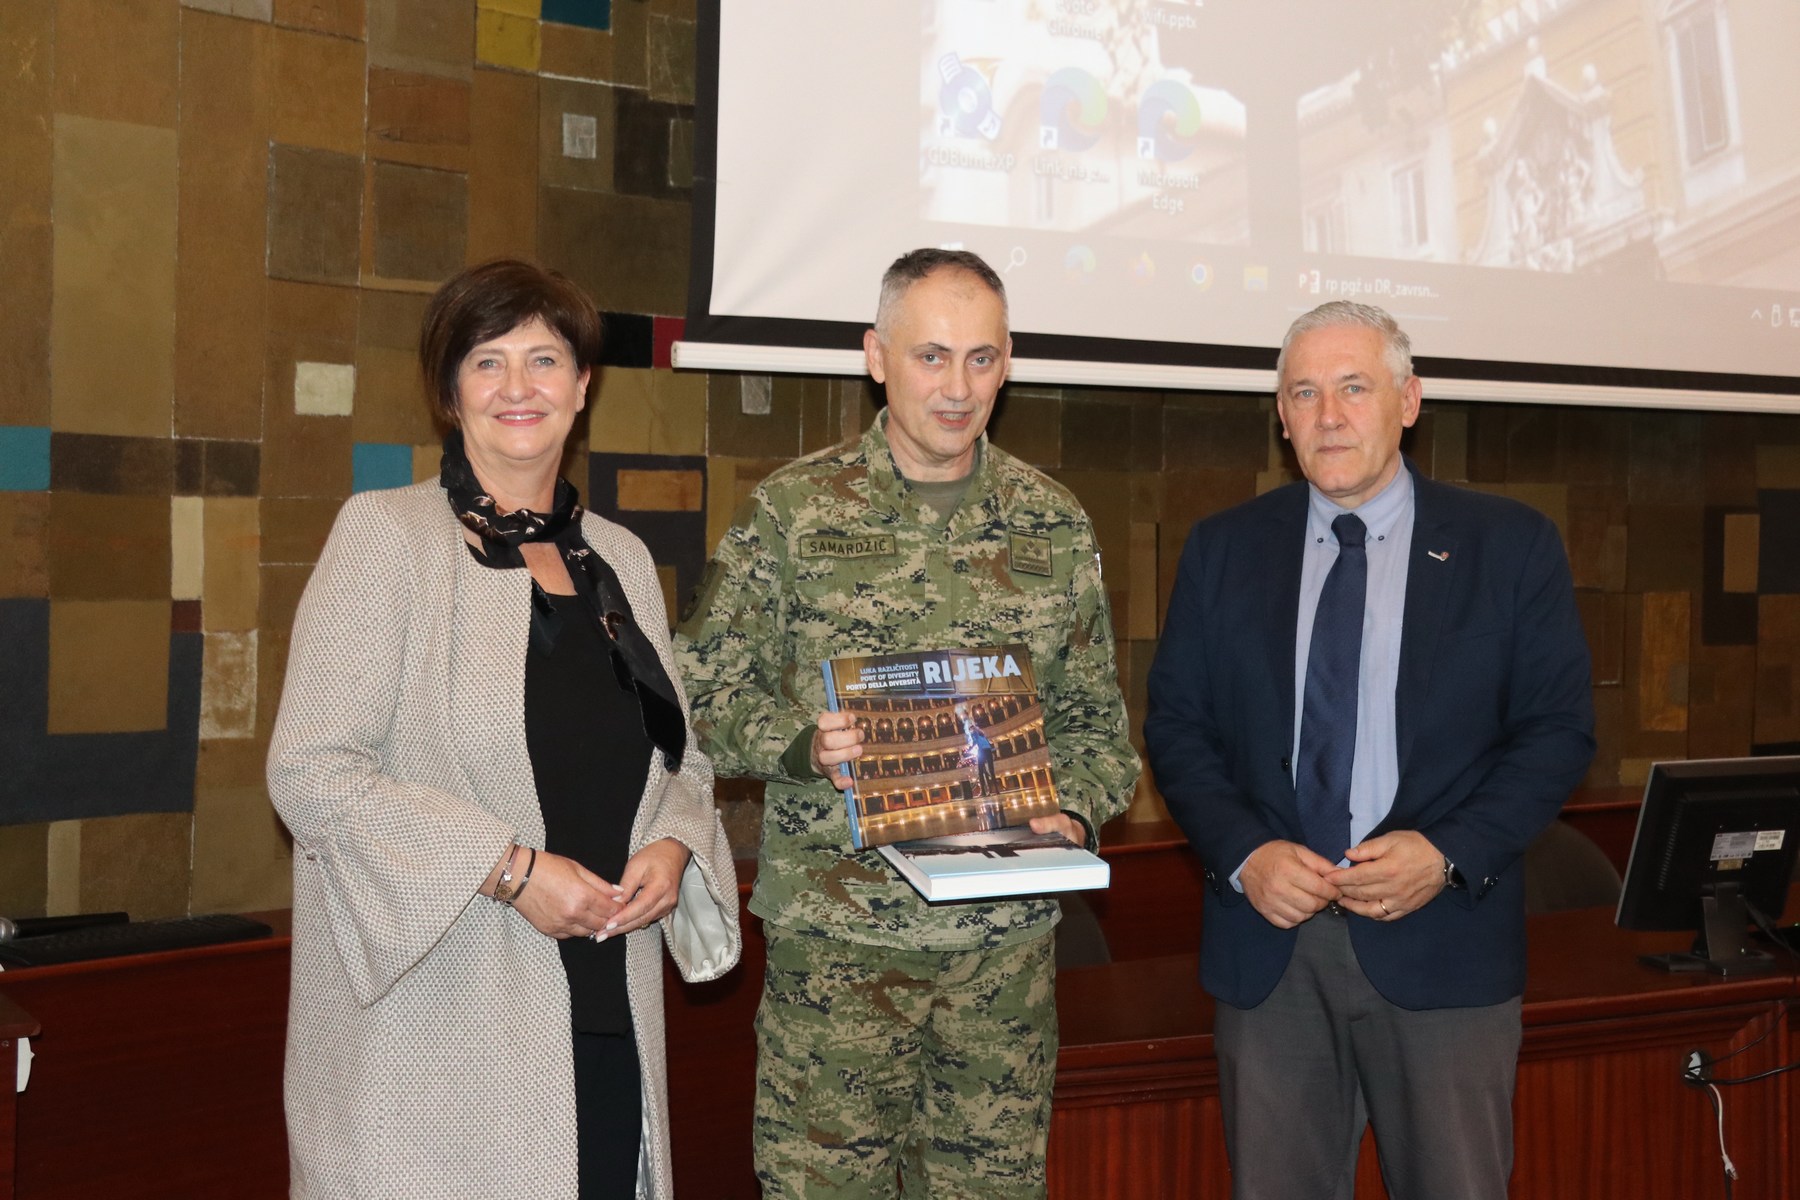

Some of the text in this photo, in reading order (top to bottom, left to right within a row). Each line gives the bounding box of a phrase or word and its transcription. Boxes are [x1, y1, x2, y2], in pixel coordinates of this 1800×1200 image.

[1137, 168, 1199, 190] Microsoft
[1152, 194, 1184, 215] Edge
[1325, 279, 1338, 294] rp
[1364, 283, 1372, 294] u
[810, 538, 887, 555] SAMARDŽIĆ
[859, 663, 919, 675] LUKA RAZLIČITOSTI
[860, 674, 877, 682] PORT
[887, 671, 919, 680] DIVERSITY
[922, 654, 1022, 685] RIJEKA
[846, 677, 922, 691] PORTO DELLA DIVERSITÀ
